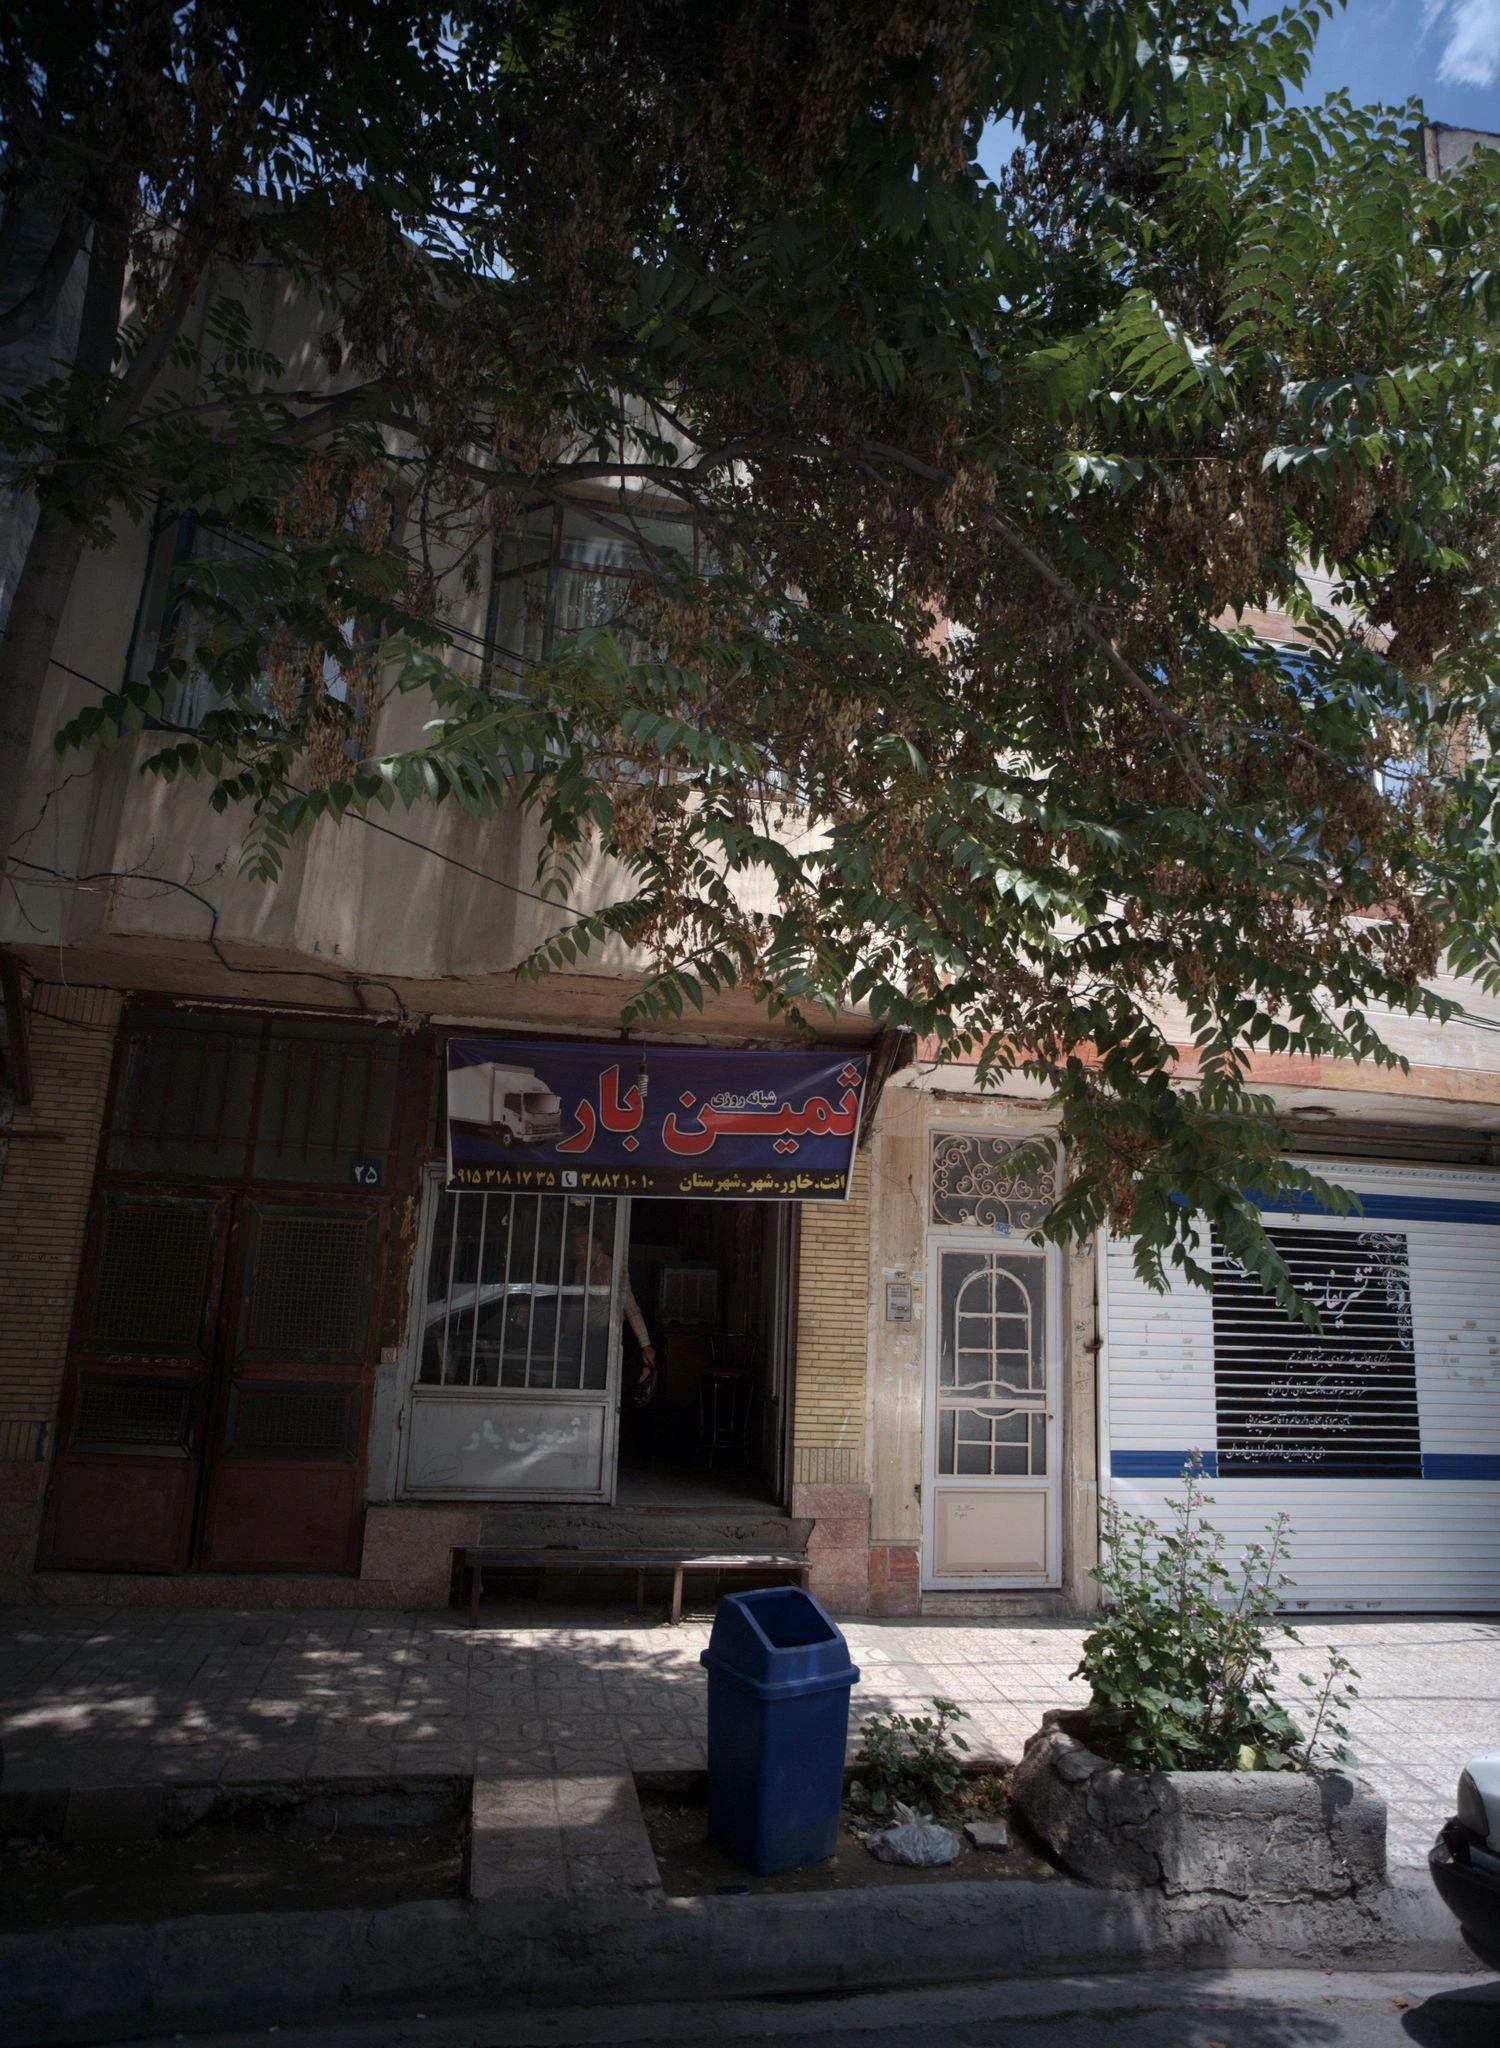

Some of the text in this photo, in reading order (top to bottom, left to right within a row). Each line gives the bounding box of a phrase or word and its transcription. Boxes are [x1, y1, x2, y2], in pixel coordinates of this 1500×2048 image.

[556, 1062, 862, 1155] ثمین بار
[711, 1090, 778, 1109] شبانه روزی
[354, 1165, 378, 1184] ۲۵
[508, 1416, 581, 1452] ثمین
